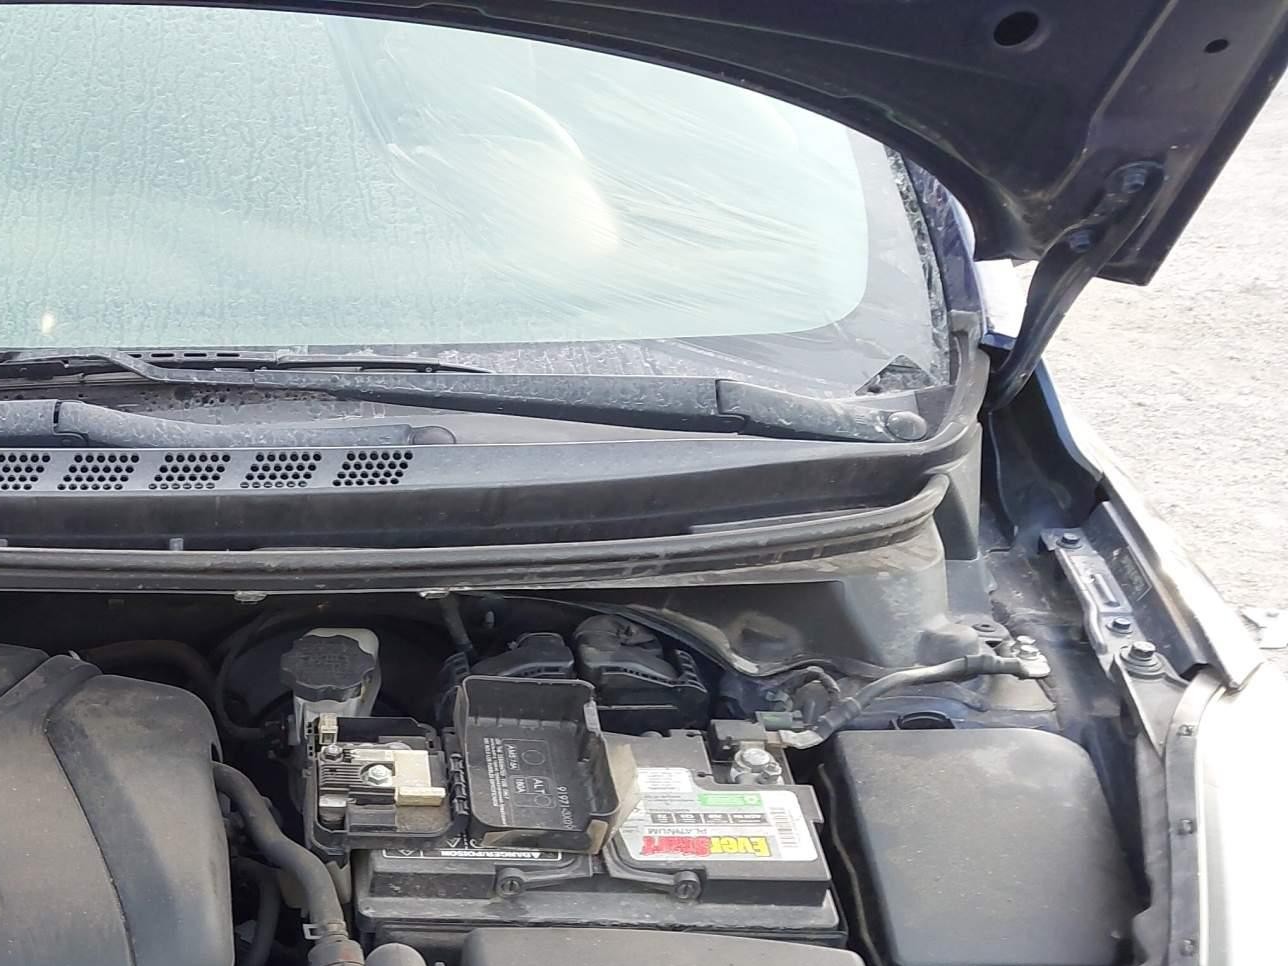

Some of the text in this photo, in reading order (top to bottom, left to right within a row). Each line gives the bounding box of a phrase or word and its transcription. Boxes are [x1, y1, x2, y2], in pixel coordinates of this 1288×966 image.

[533, 778, 546, 795] ALT
[646, 827, 708, 835] PLATINUM
[640, 836, 771, 858] EverStart
